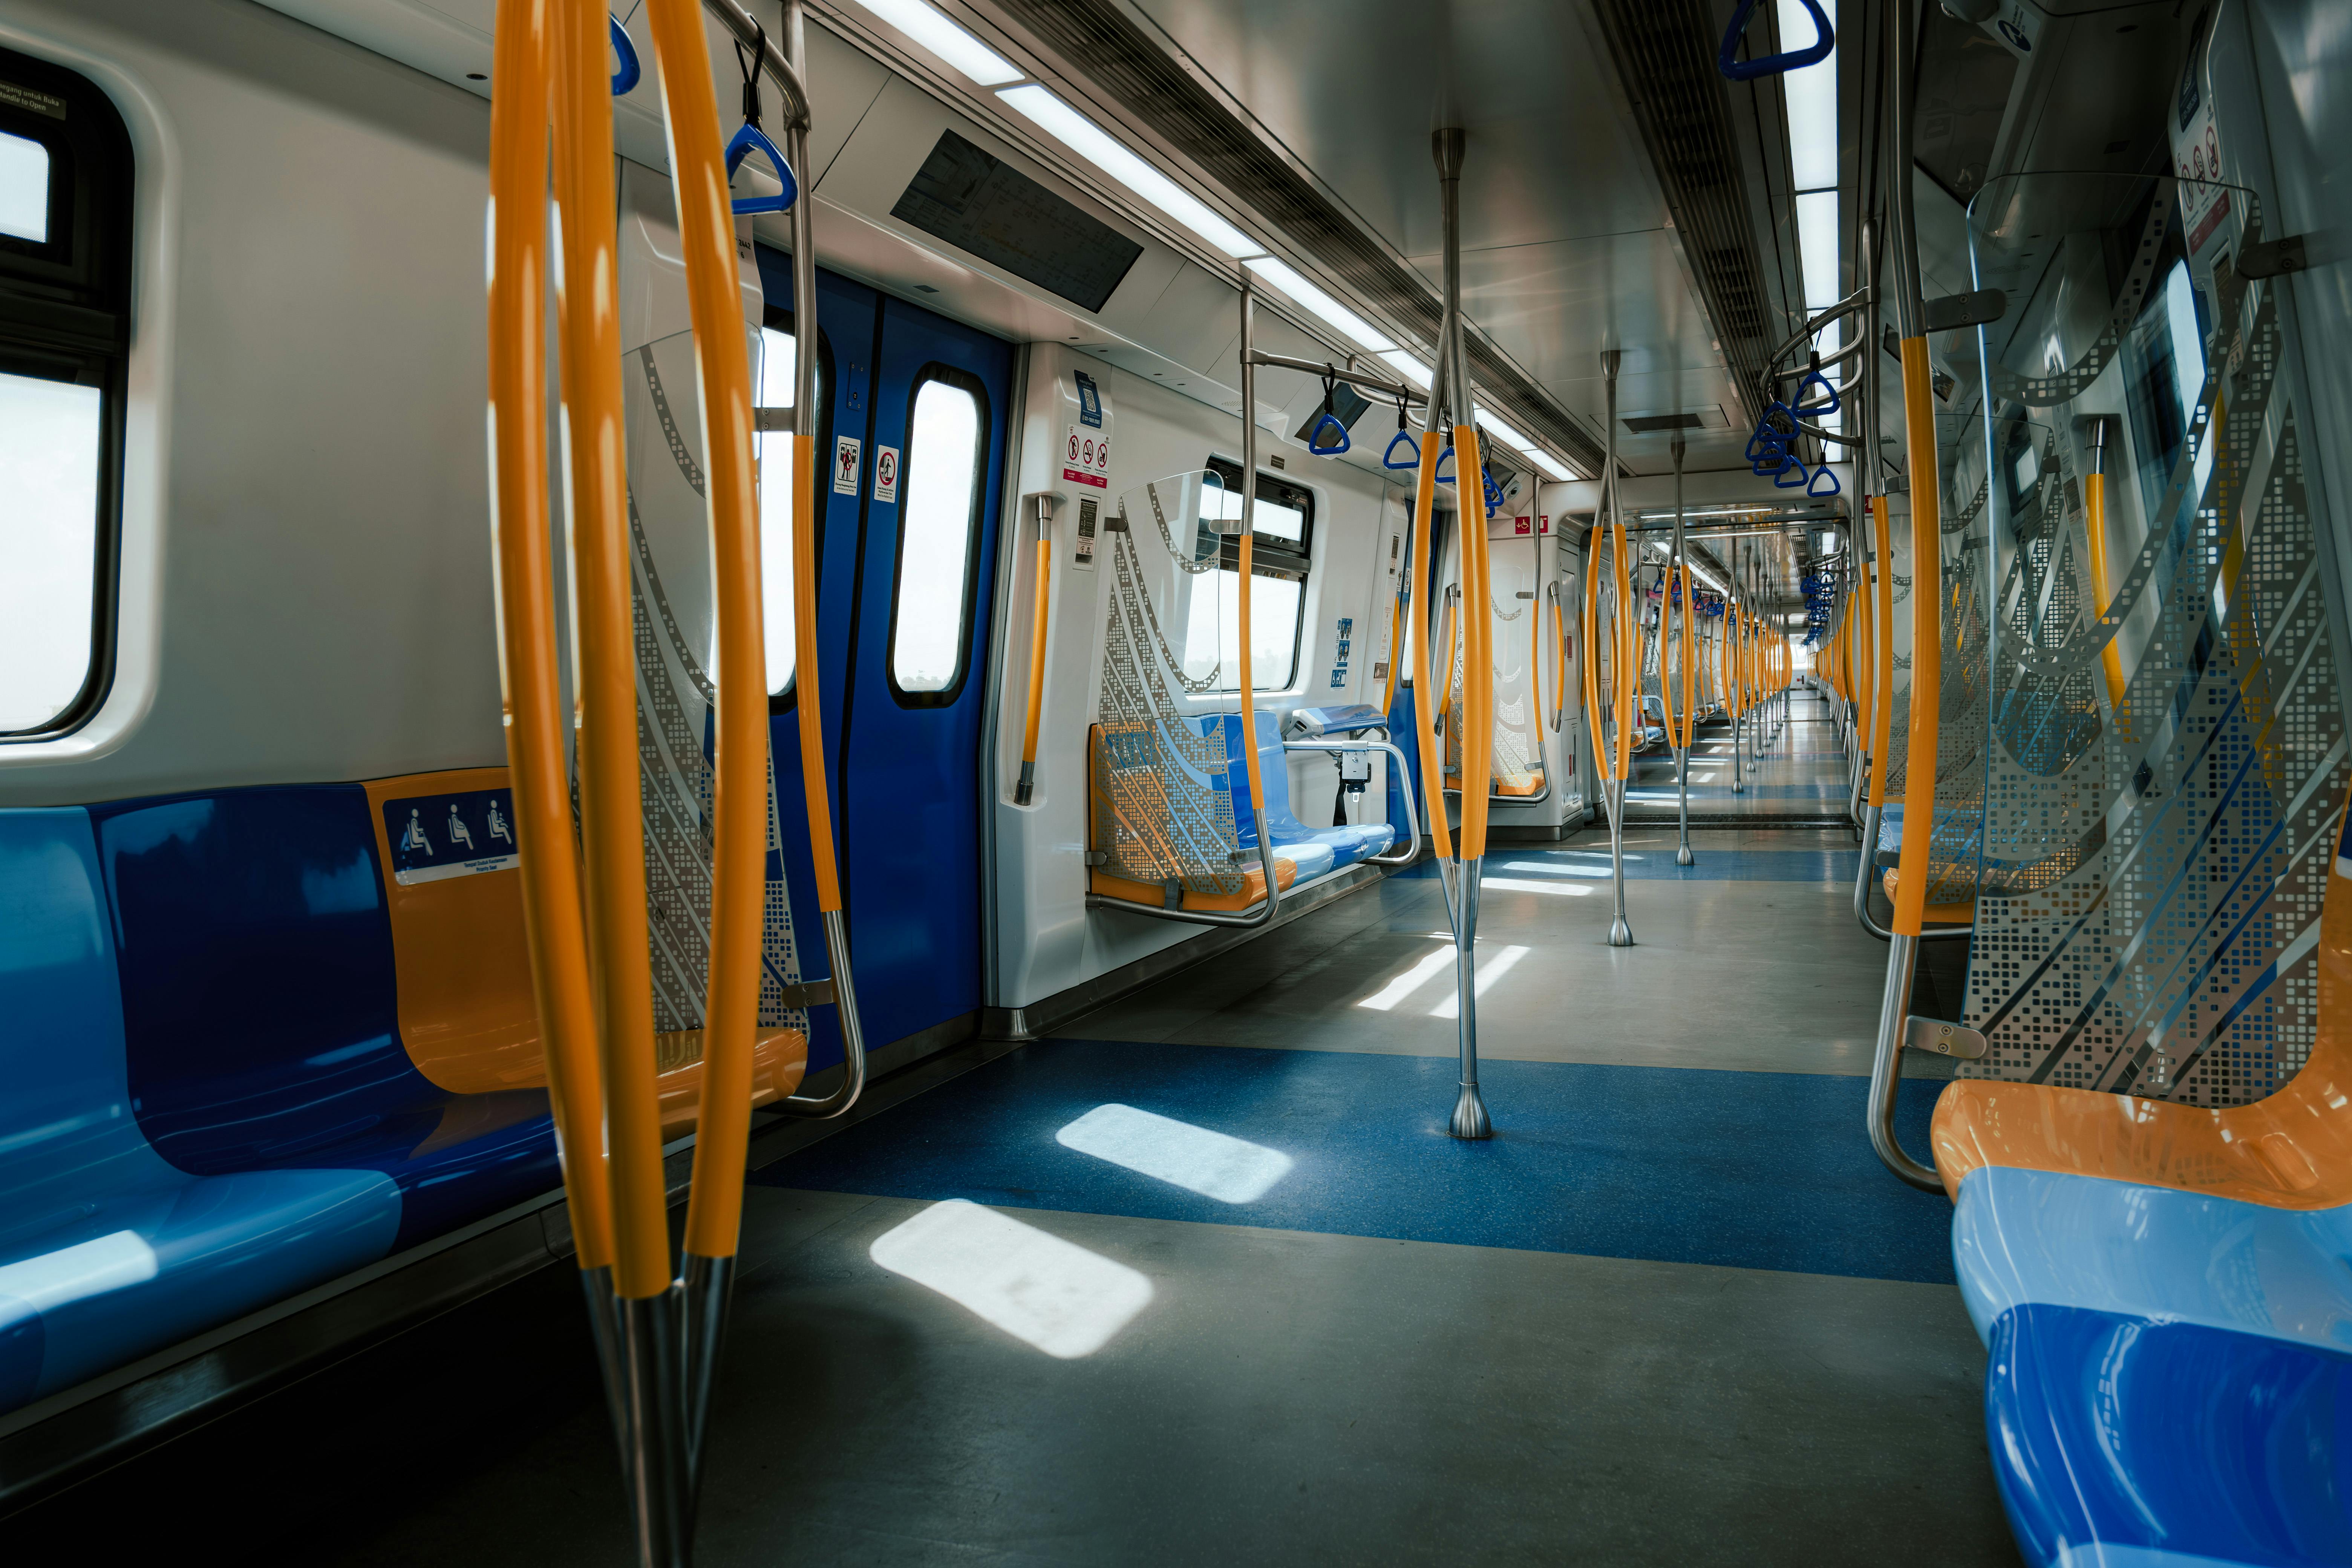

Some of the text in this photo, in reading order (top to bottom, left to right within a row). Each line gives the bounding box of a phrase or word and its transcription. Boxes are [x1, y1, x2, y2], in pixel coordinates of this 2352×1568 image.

[23, 91, 41, 101] untuk
[43, 95, 59, 106] Buka
[30, 101, 46, 111] Open
[738, 239, 751, 250] 2442
